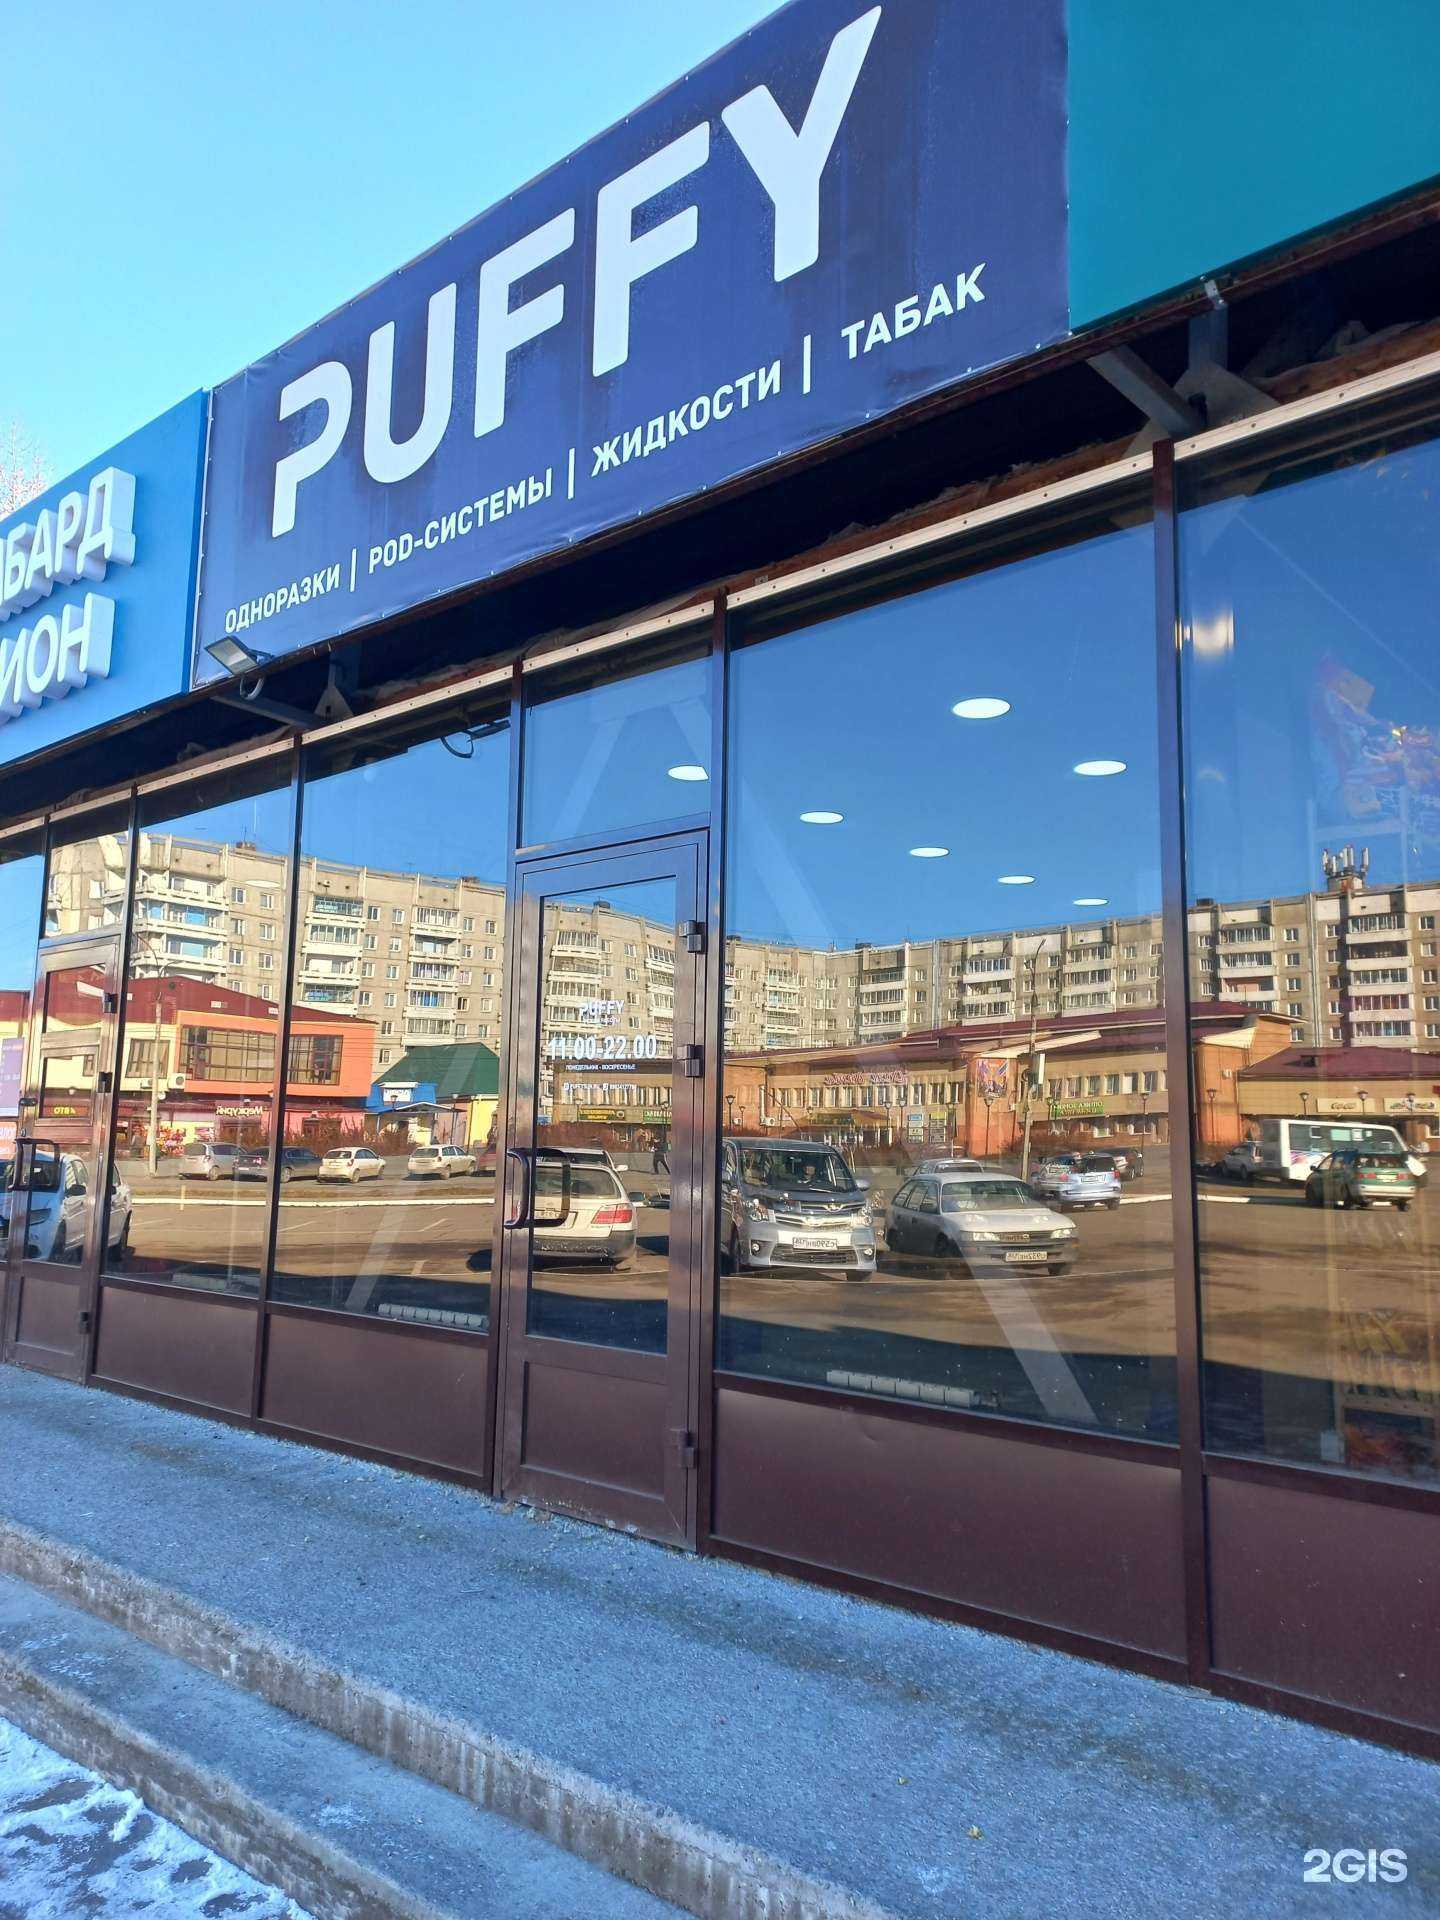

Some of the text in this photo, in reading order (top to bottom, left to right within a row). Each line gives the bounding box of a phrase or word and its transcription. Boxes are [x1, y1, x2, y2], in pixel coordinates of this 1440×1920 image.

[272, 2, 883, 539] PUFFY
[840, 262, 986, 361] ТАБАК
[590, 359, 781, 477] ЖИДКОСТИ
[0, 466, 118, 605] БАРД
[368, 466, 553, 574] POD-СИСТЕМЫ
[224, 562, 341, 634] ОДНОРАЗКИ
[548, 1033, 657, 1060] 11.00-22.00
[580, 999, 625, 1018] PUFFY
